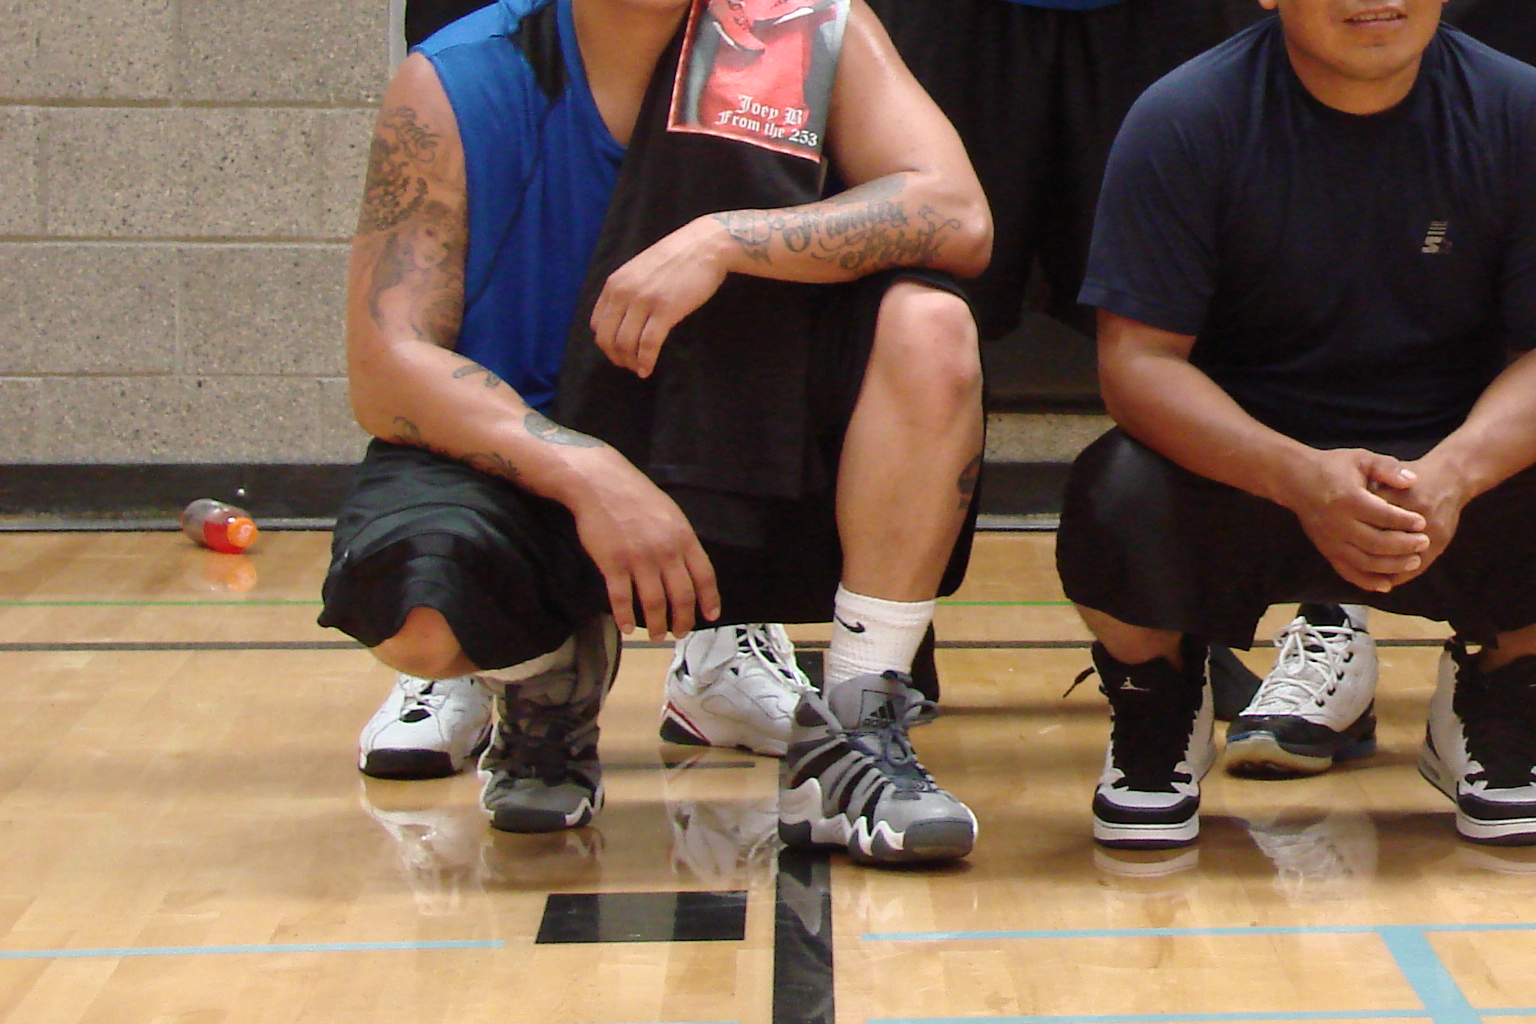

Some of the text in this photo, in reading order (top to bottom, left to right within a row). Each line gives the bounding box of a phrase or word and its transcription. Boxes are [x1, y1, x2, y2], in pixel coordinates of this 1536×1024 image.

[735, 94, 779, 120] Joey
[714, 110, 818, 147] From the 253
